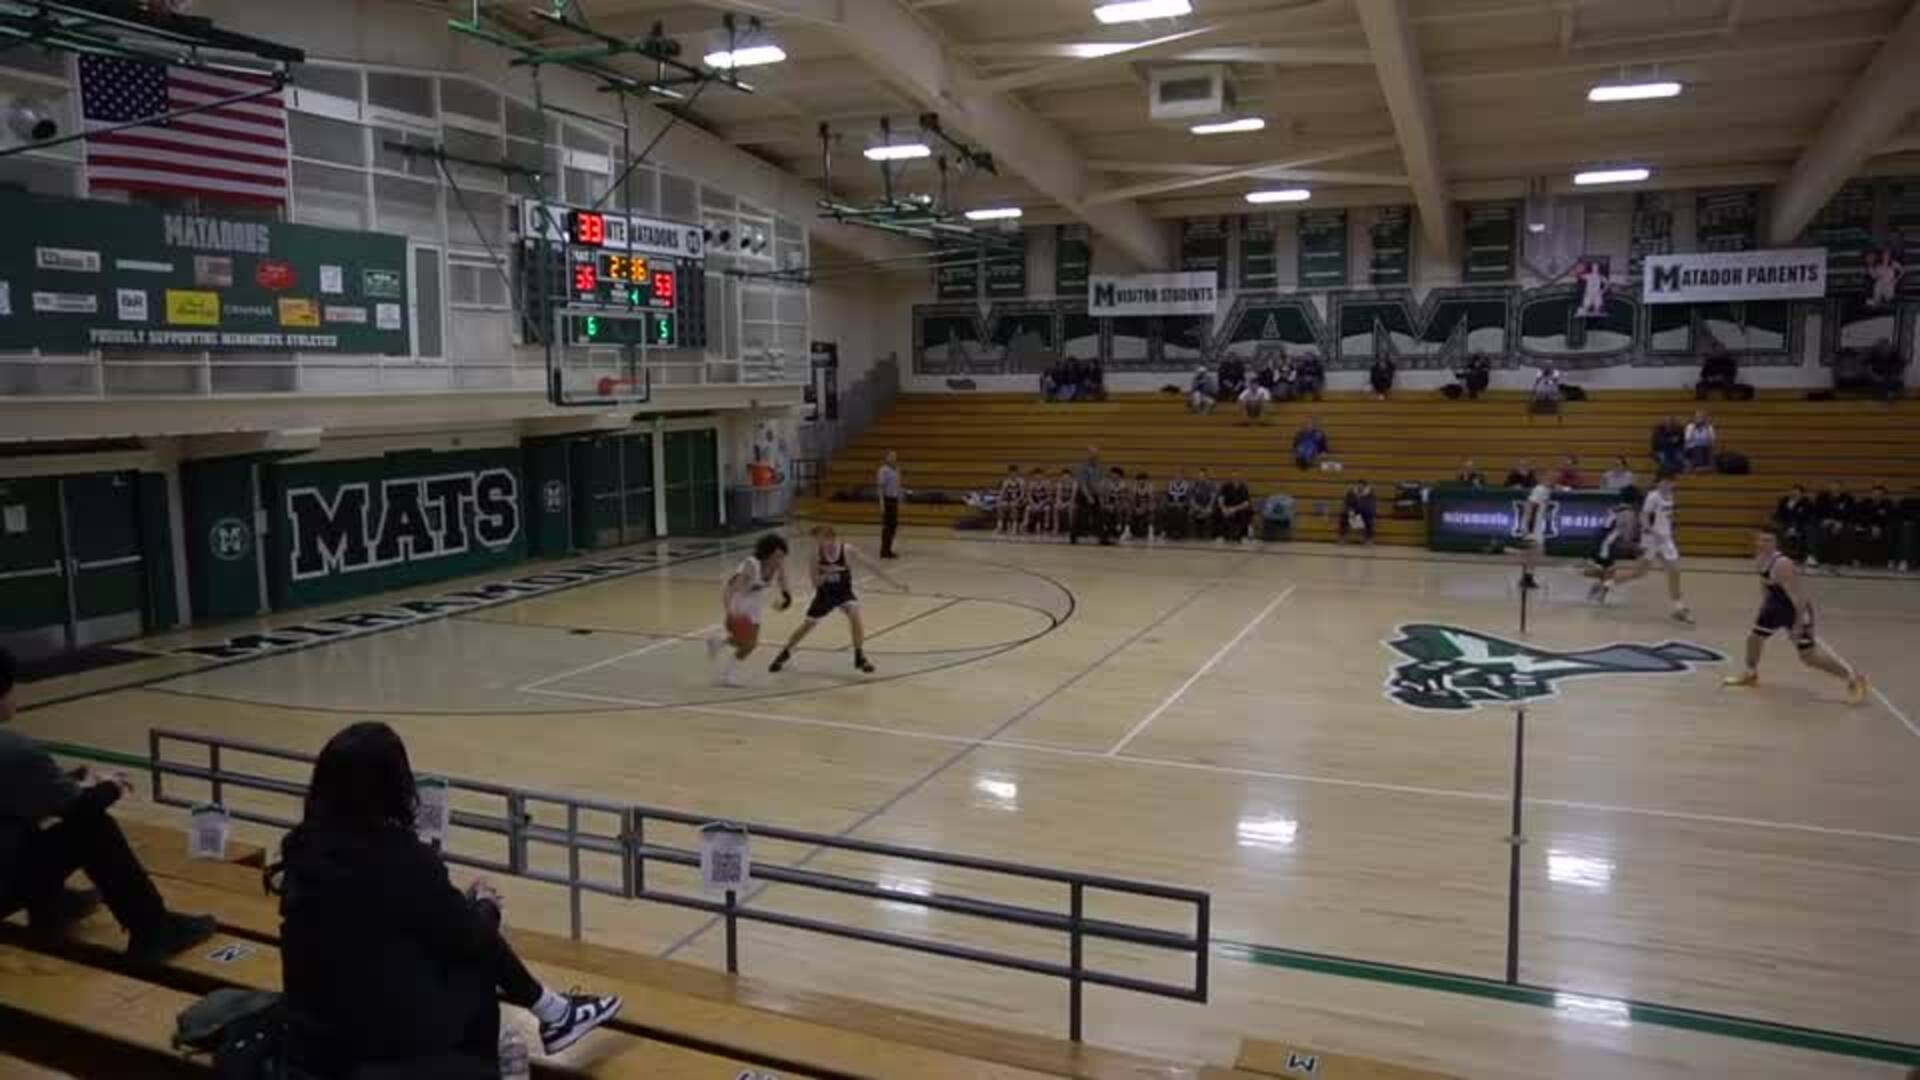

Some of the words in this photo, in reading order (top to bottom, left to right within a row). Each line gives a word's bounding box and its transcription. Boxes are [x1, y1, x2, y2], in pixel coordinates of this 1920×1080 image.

[1653, 264, 1743, 292] MATADOR
[1747, 264, 1819, 284] PARENTS
[287, 467, 519, 580] MATS
